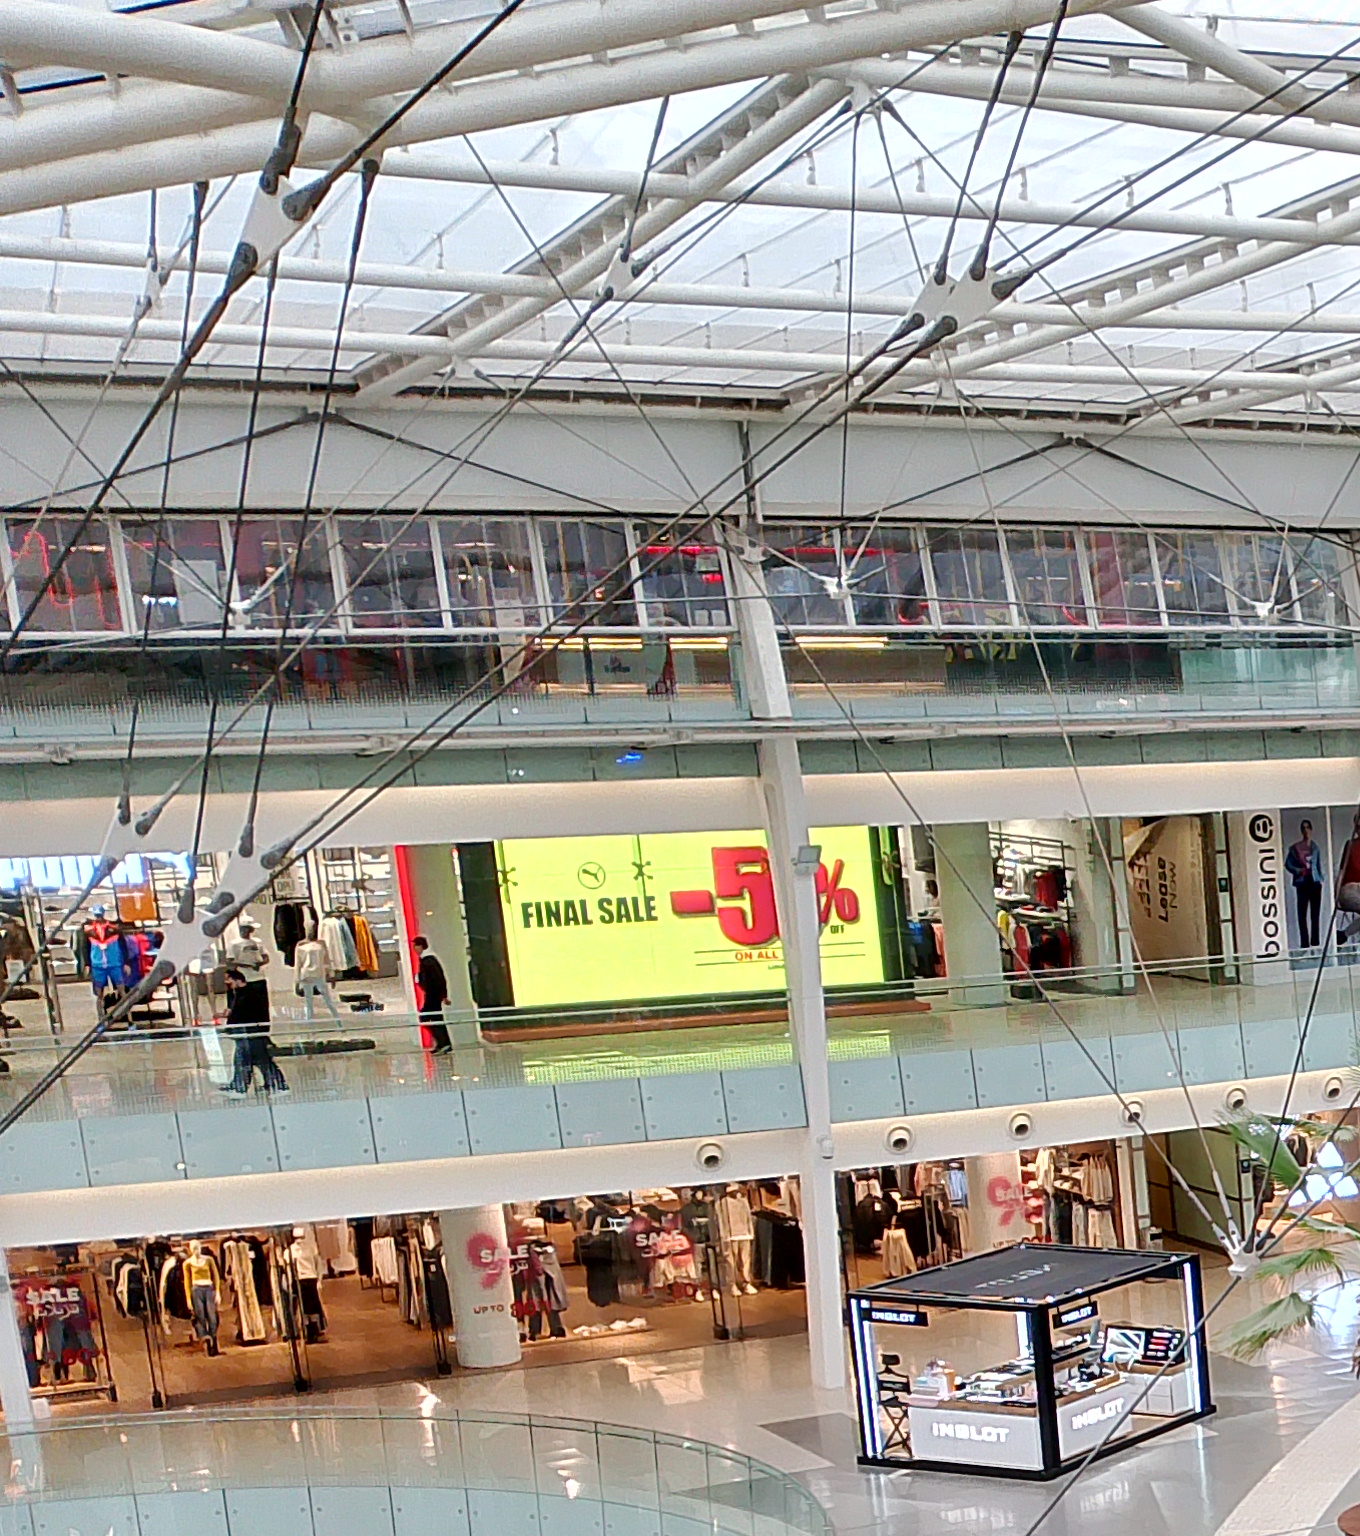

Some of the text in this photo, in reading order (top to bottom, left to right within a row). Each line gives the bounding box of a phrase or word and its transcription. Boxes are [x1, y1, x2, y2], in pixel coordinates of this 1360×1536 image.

[521, 895, 658, 929] FINAL SALE
[1256, 848, 1280, 959] bossini
[735, 949, 779, 961] ON ALL
[26, 1287, 80, 1305] SALE
[1071, 1398, 1125, 1430] INGLOT
[932, 1421, 1010, 1442] INGLOT
